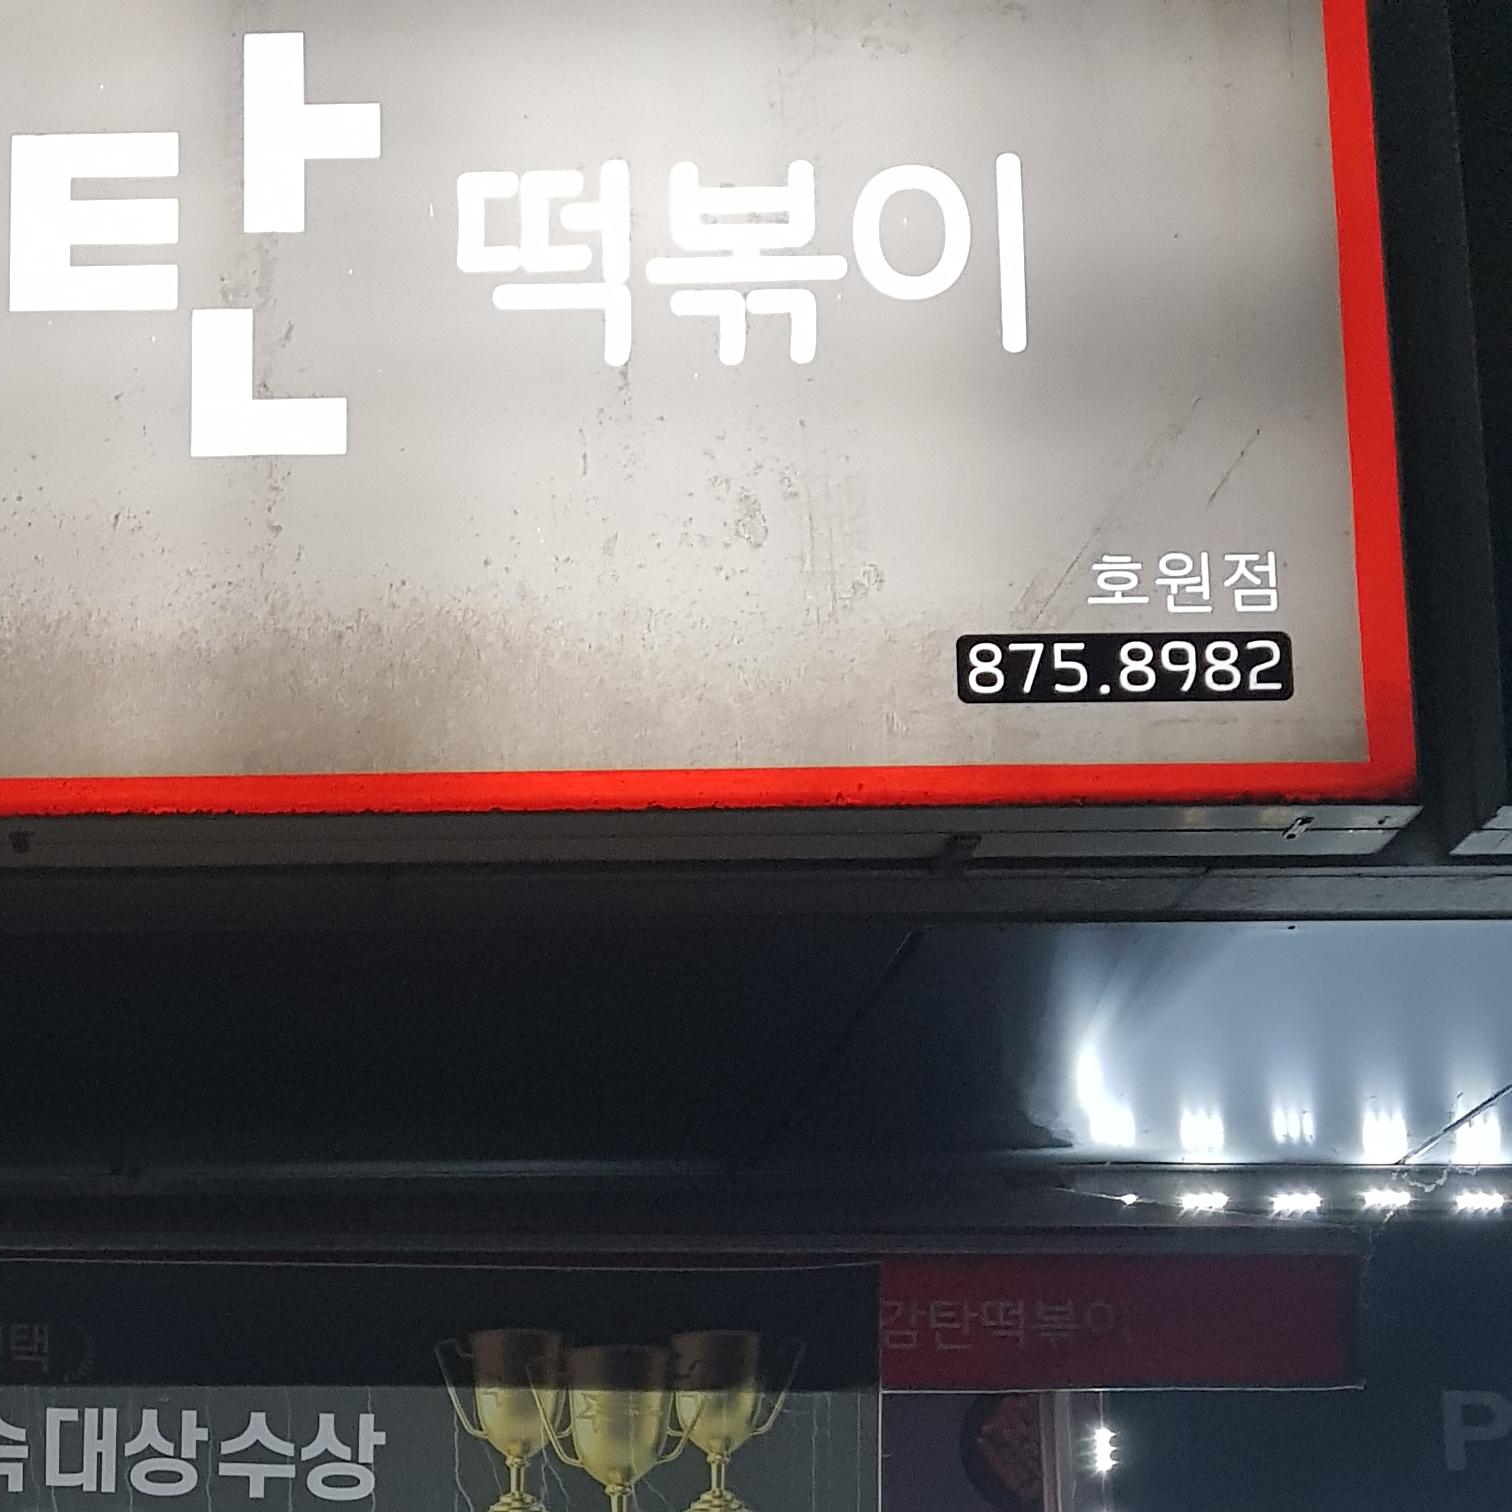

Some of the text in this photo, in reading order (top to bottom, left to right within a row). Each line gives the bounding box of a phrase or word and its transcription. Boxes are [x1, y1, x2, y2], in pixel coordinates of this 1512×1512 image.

[455, 152, 1028, 368] 떡볶이
[1087, 550, 1280, 613] 호원점
[966, 639, 1284, 696] 875.8982
